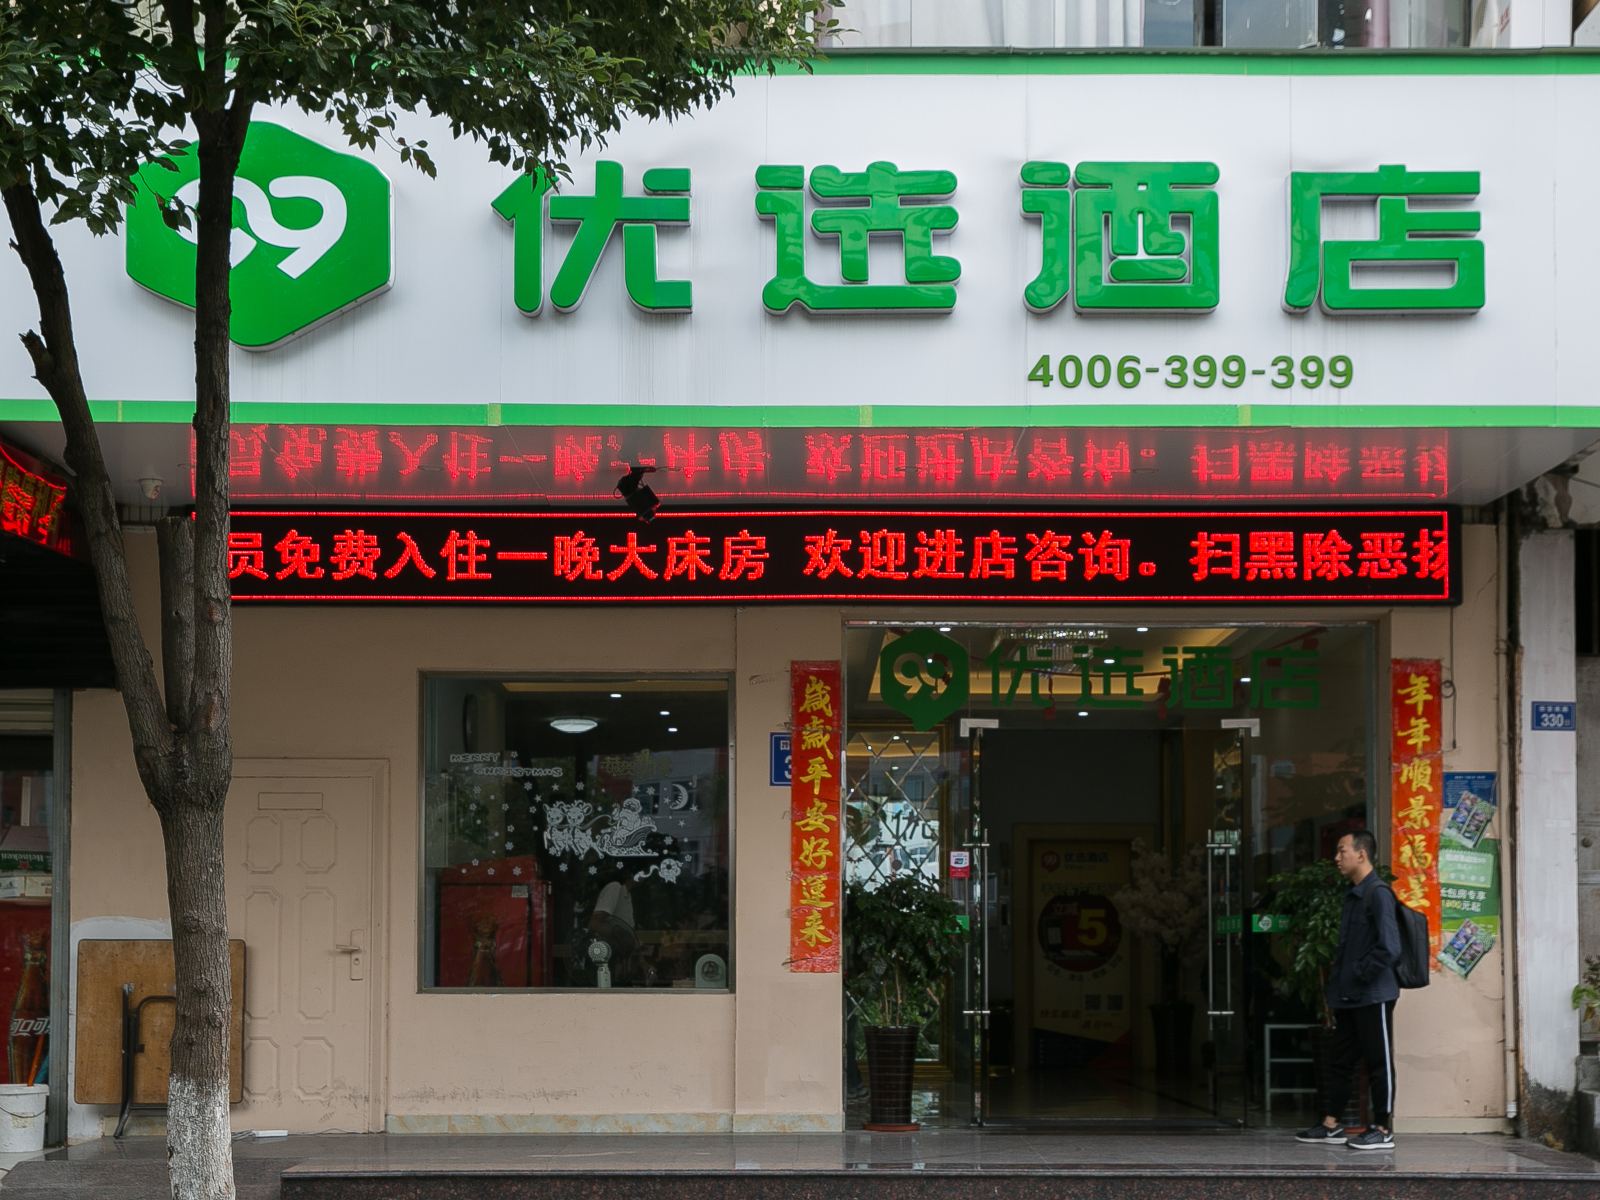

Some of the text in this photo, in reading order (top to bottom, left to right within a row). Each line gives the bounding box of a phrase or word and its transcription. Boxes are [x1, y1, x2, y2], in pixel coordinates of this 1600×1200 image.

[493, 160, 1486, 314] 优选酒店
[1028, 354, 1354, 389] 4006-399-399
[227, 529, 769, 582] 员免费入住一晚大床房
[804, 528, 1157, 582] 欢迎进店咨询。
[984, 645, 1321, 709] 优选酒店
[449, 752, 501, 763] MERRY
[473, 767, 563, 777] CHRISTMAS
[1397, 674, 1434, 912] 年年順景福星
[1077, 909, 1108, 946] 5
[9, 1017, 51, 1037] 可口可
